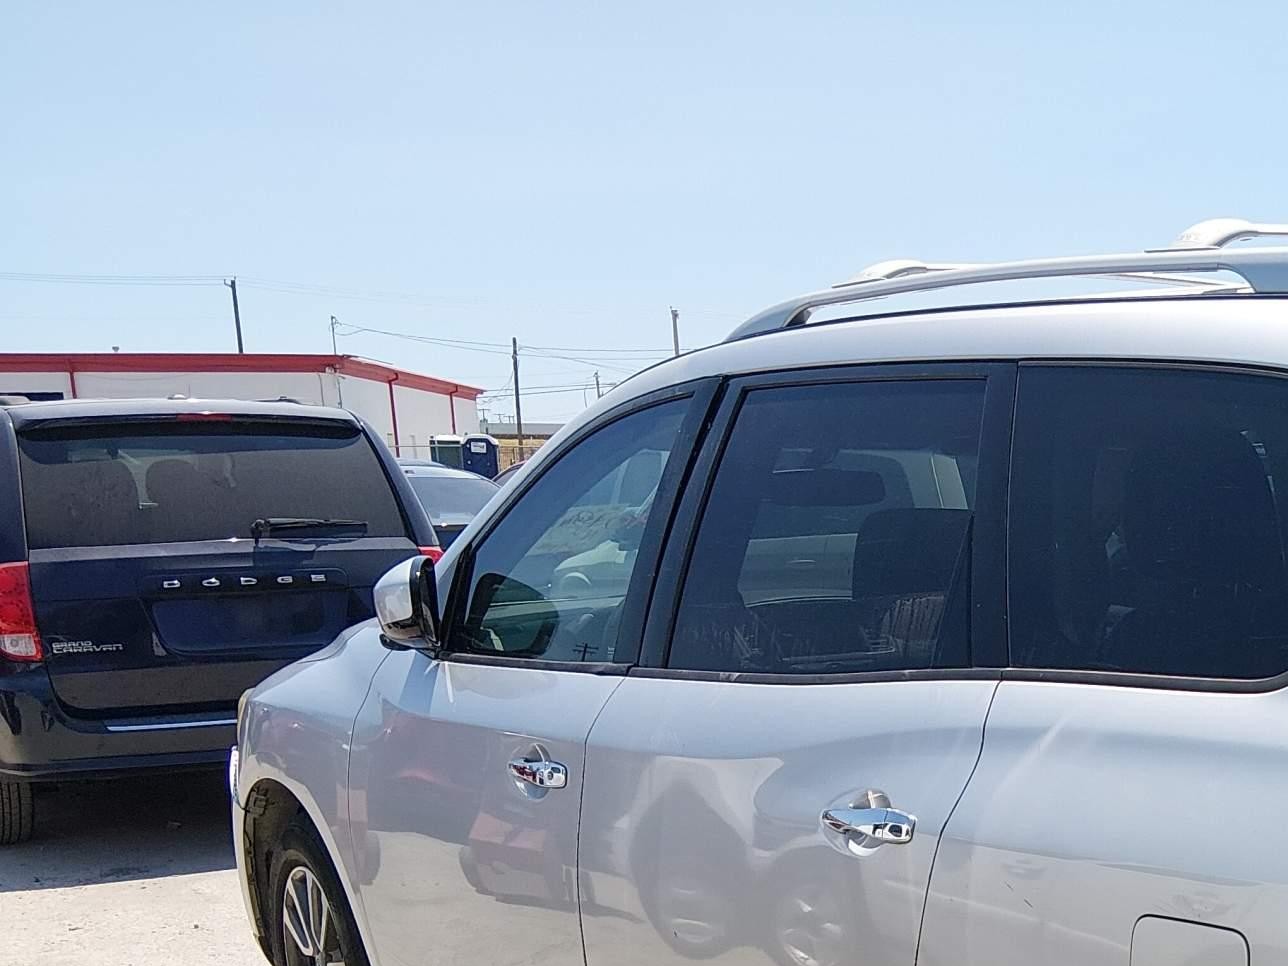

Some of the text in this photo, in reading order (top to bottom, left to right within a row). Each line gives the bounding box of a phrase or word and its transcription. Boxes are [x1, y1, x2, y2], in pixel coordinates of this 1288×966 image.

[162, 573, 327, 589] DODGE
[51, 640, 93, 648] GRAND
[52, 643, 125, 654] CARAVAN
